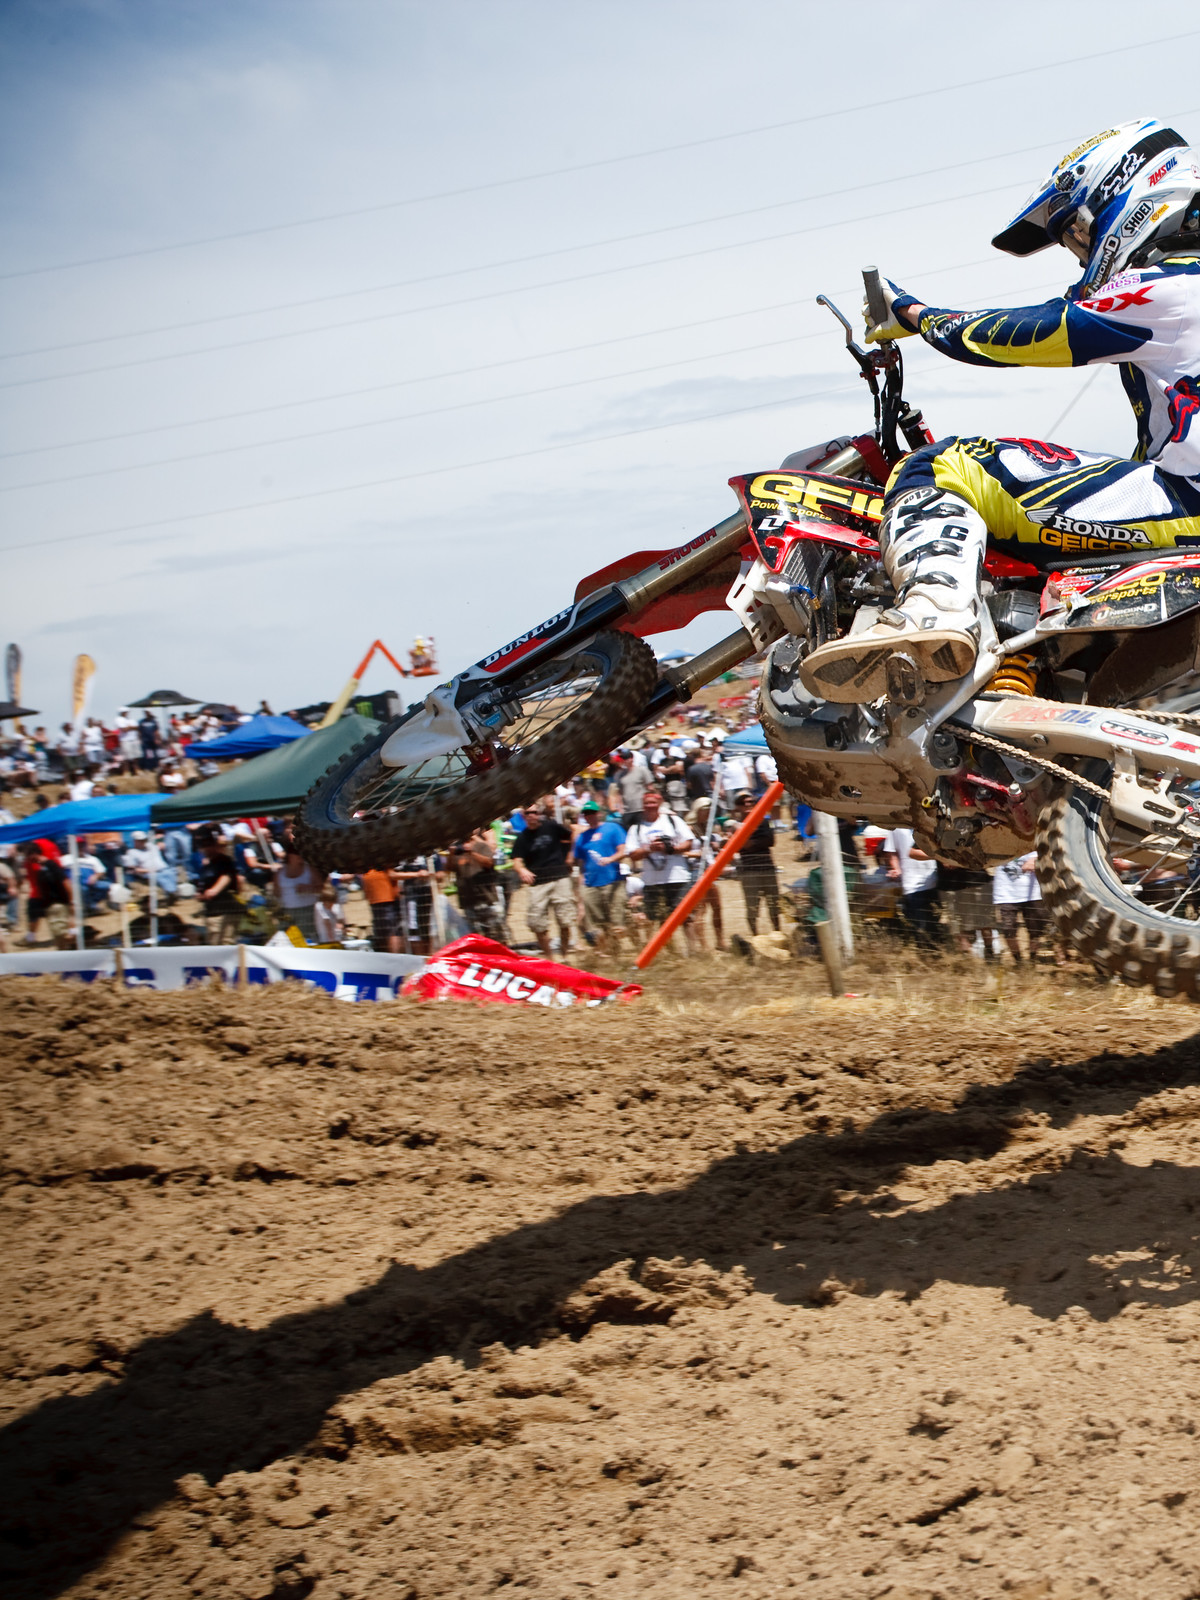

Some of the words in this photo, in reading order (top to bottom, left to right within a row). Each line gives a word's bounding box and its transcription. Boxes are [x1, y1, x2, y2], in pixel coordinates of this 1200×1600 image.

[1148, 157, 1178, 187] AMSOIL
[1123, 202, 1152, 234] SHOEI
[1073, 284, 1157, 313] OX
[749, 473, 887, 521] GEI
[1040, 527, 1133, 551] GEICO
[1052, 514, 1152, 544] HONDA
[657, 528, 717, 571] SHOWA
[1095, 603, 1158, 621] UNBOUND
[484, 605, 574, 667] DUNLOP
[1003, 705, 1098, 724] AMSOIL
[458, 963, 577, 1009] LUCAS
